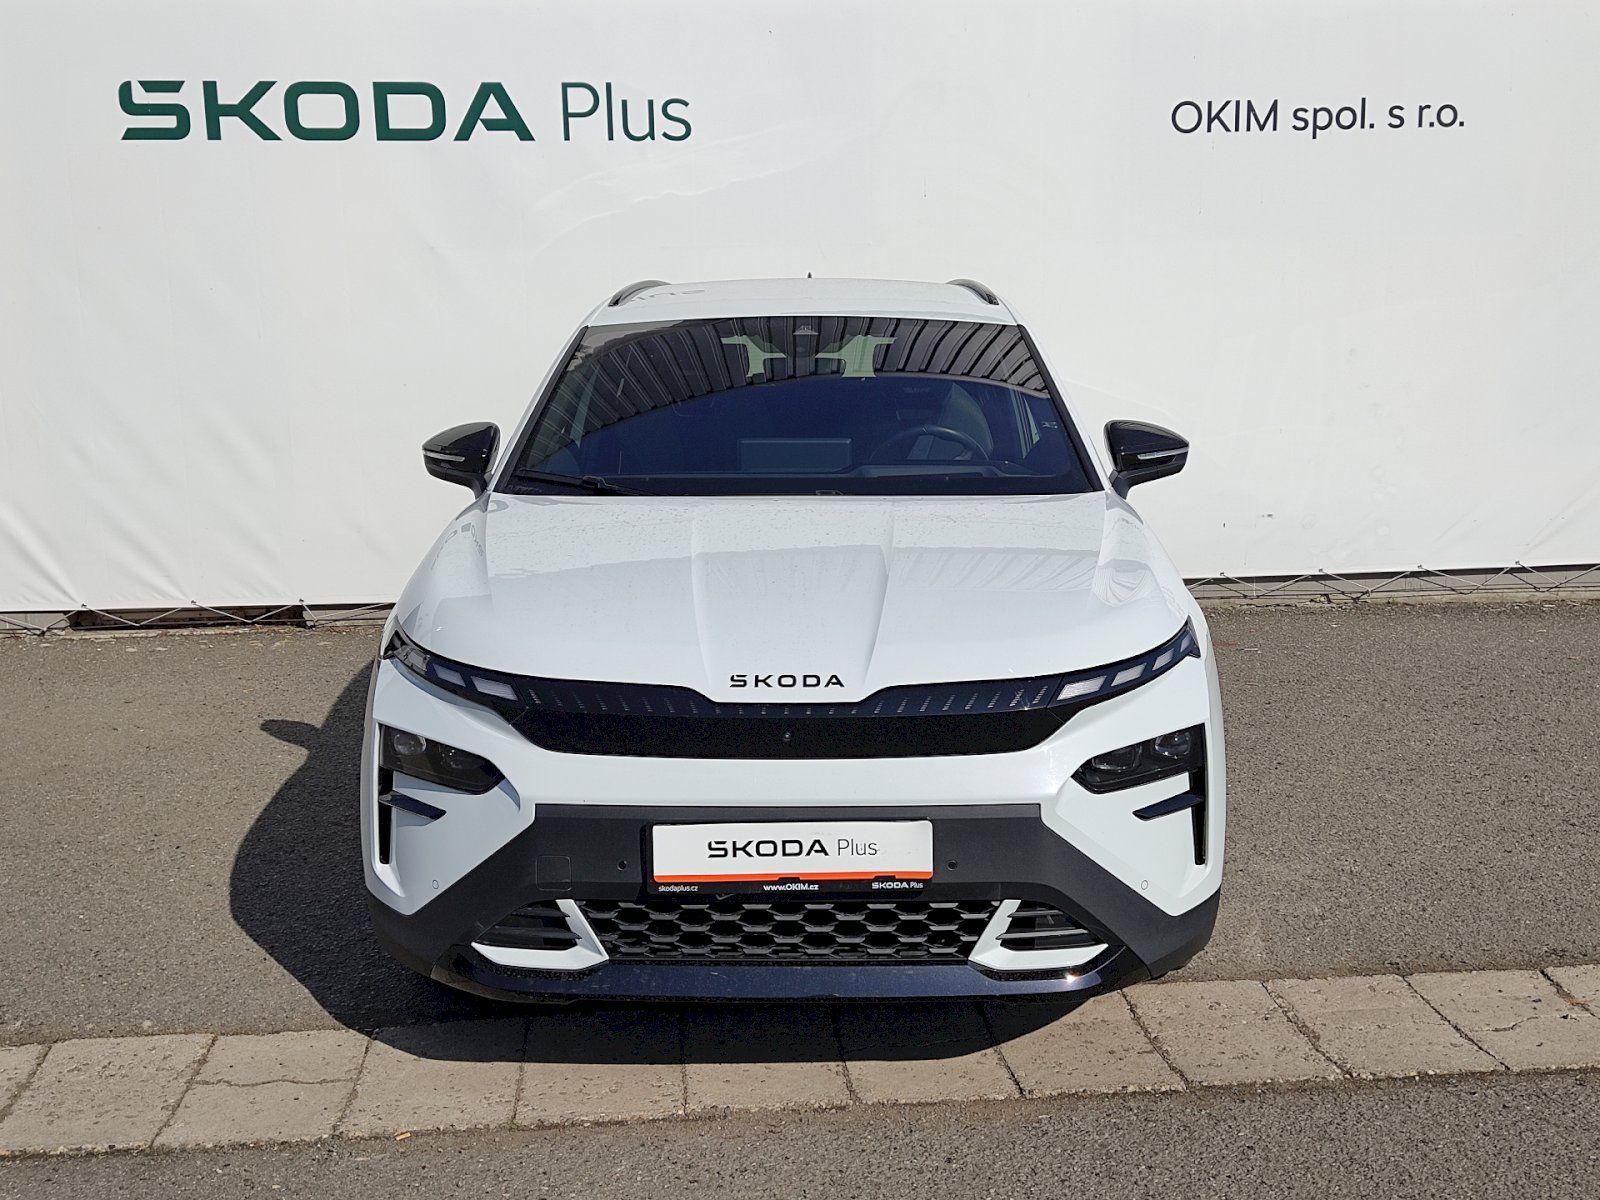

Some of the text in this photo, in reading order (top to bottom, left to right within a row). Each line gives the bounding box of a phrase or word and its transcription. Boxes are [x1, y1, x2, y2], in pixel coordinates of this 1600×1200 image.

[561, 81, 692, 142] Plus
[1171, 97, 1465, 139] OKIM spol. s r.o.
[837, 838, 878, 857] Plus
[658, 884, 699, 893] skodaplus.cz
[763, 883, 820, 891] www.OKIM.cz
[909, 881, 924, 889] Plus
